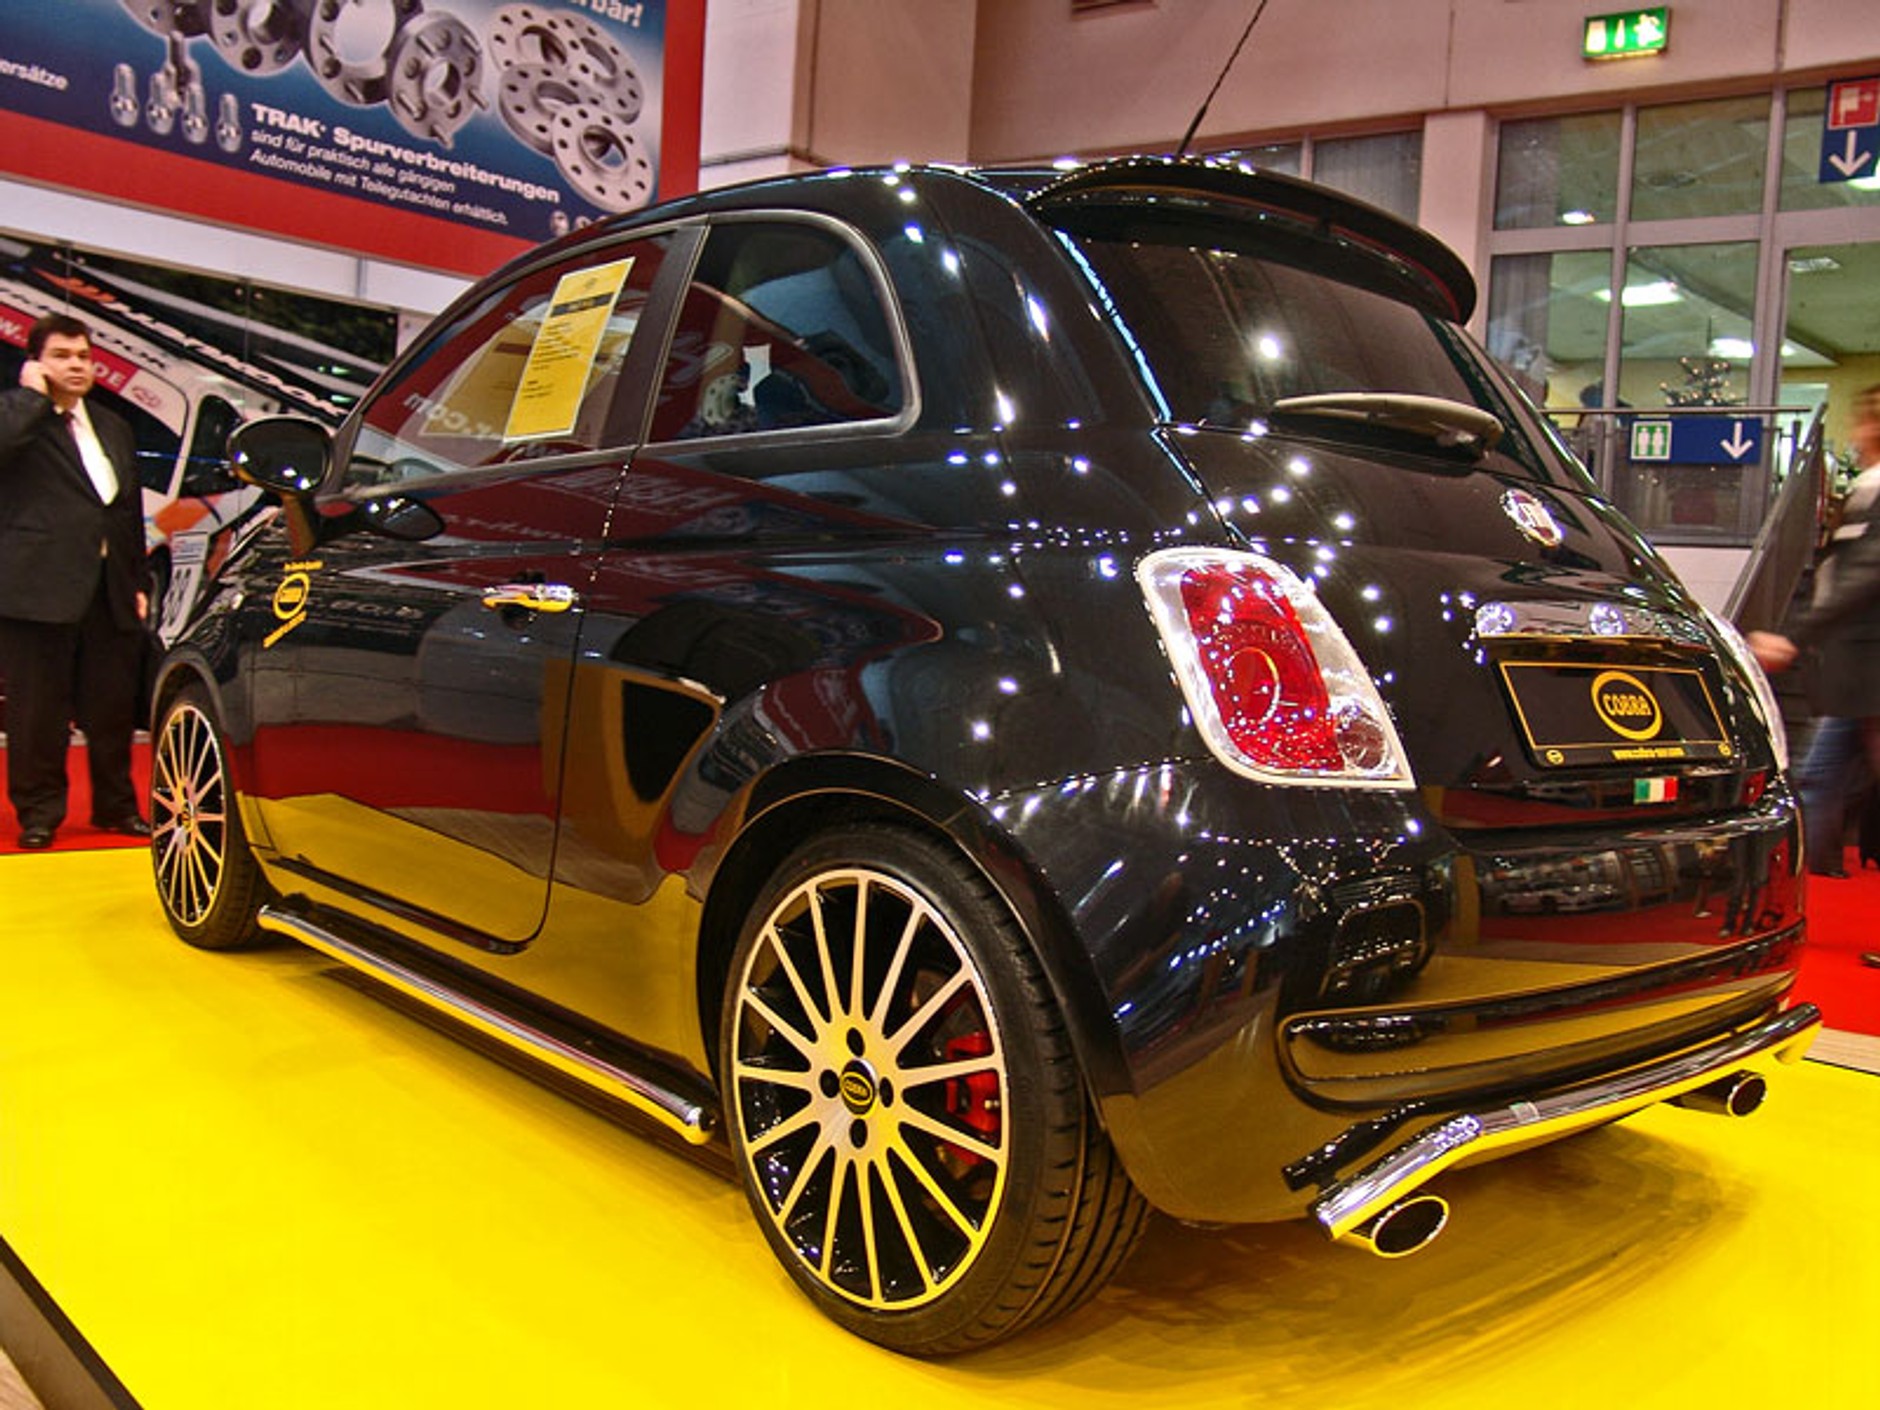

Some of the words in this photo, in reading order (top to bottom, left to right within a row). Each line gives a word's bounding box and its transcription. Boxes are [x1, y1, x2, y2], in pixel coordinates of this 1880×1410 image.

[249, 149, 332, 181] Automobile
[334, 172, 357, 187] mit
[251, 129, 283, 147] sind
[285, 136, 306, 154] für
[307, 145, 370, 170] praktisch
[372, 162, 396, 178] alle
[333, 126, 560, 203] Spurverbreiterungen
